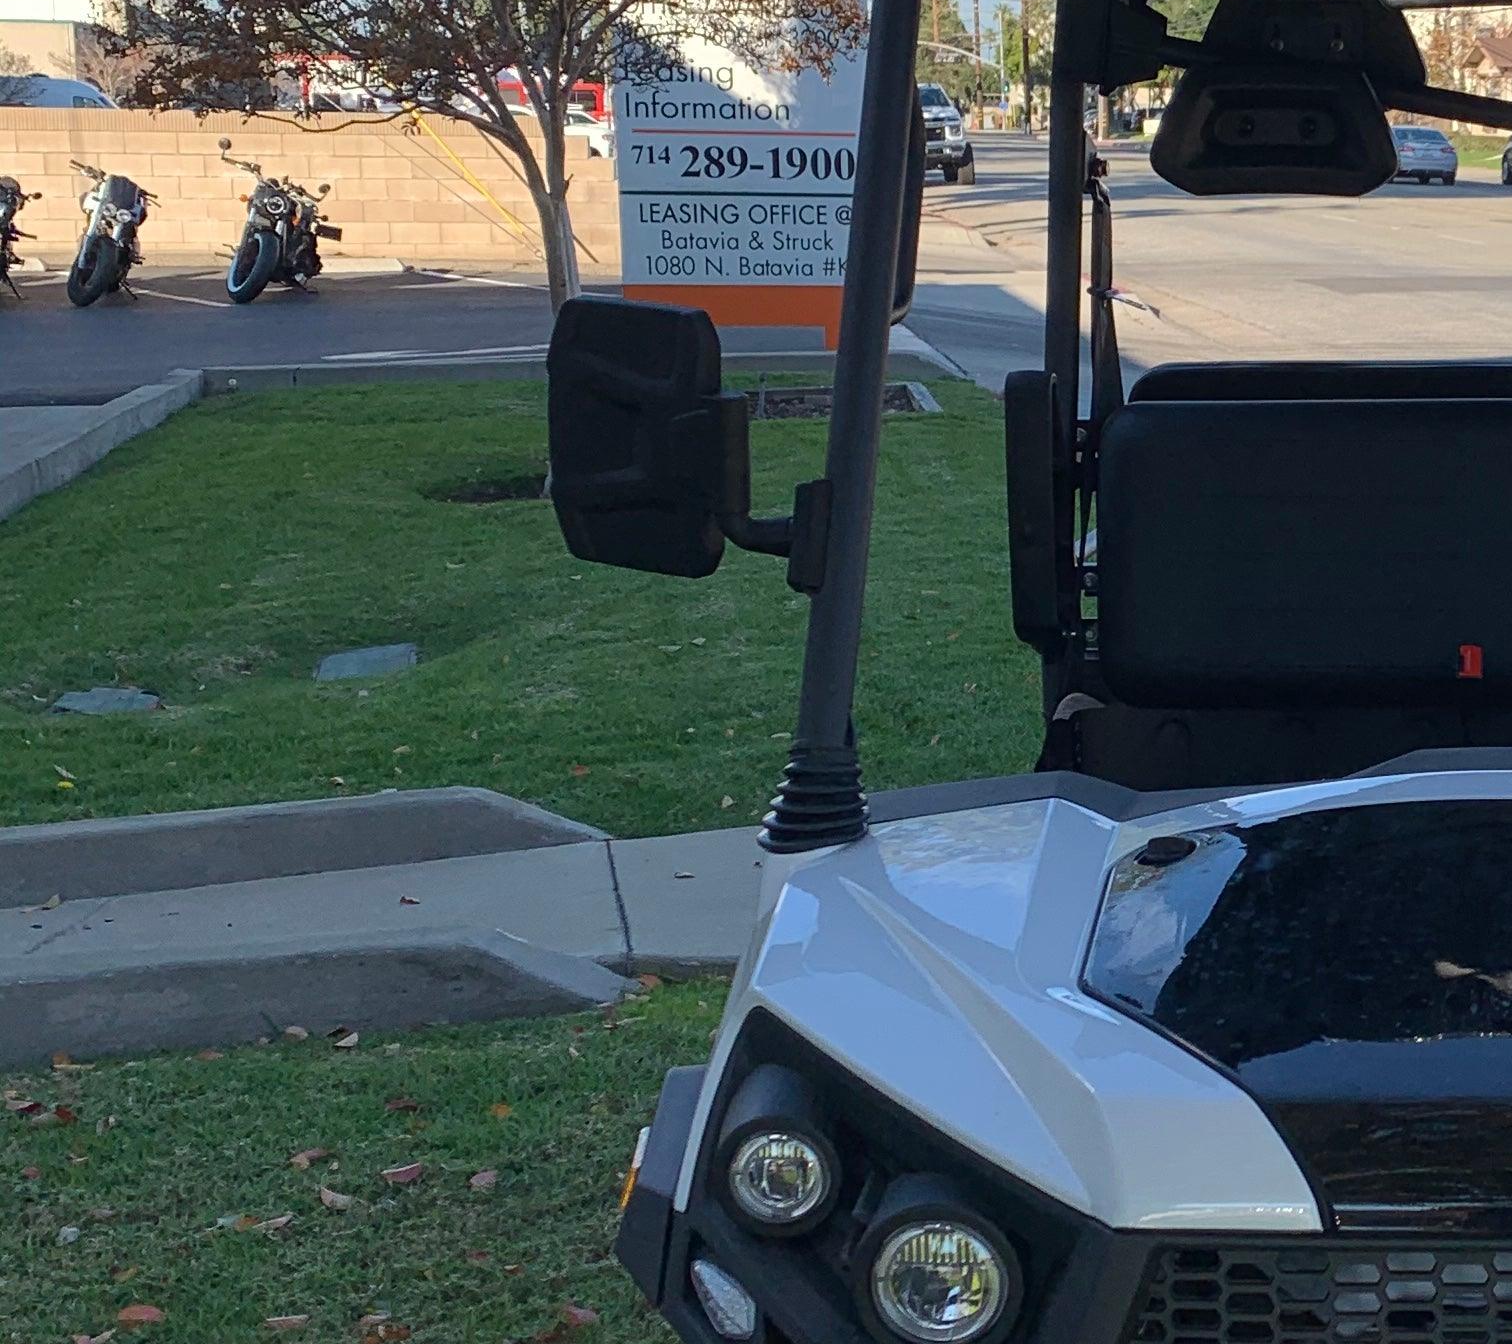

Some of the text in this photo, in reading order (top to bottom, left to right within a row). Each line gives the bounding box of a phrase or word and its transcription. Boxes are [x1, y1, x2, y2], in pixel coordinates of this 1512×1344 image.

[622, 52, 734, 91] Leasing
[625, 91, 790, 121] Information
[631, 144, 855, 181] 714 289-1900
[639, 203, 852, 226] LEASING OFFICE @
[661, 229, 834, 252] Batavia & Struck
[645, 255, 696, 276] 1080
[705, 256, 730, 277] N.
[739, 256, 814, 277] Batavia
